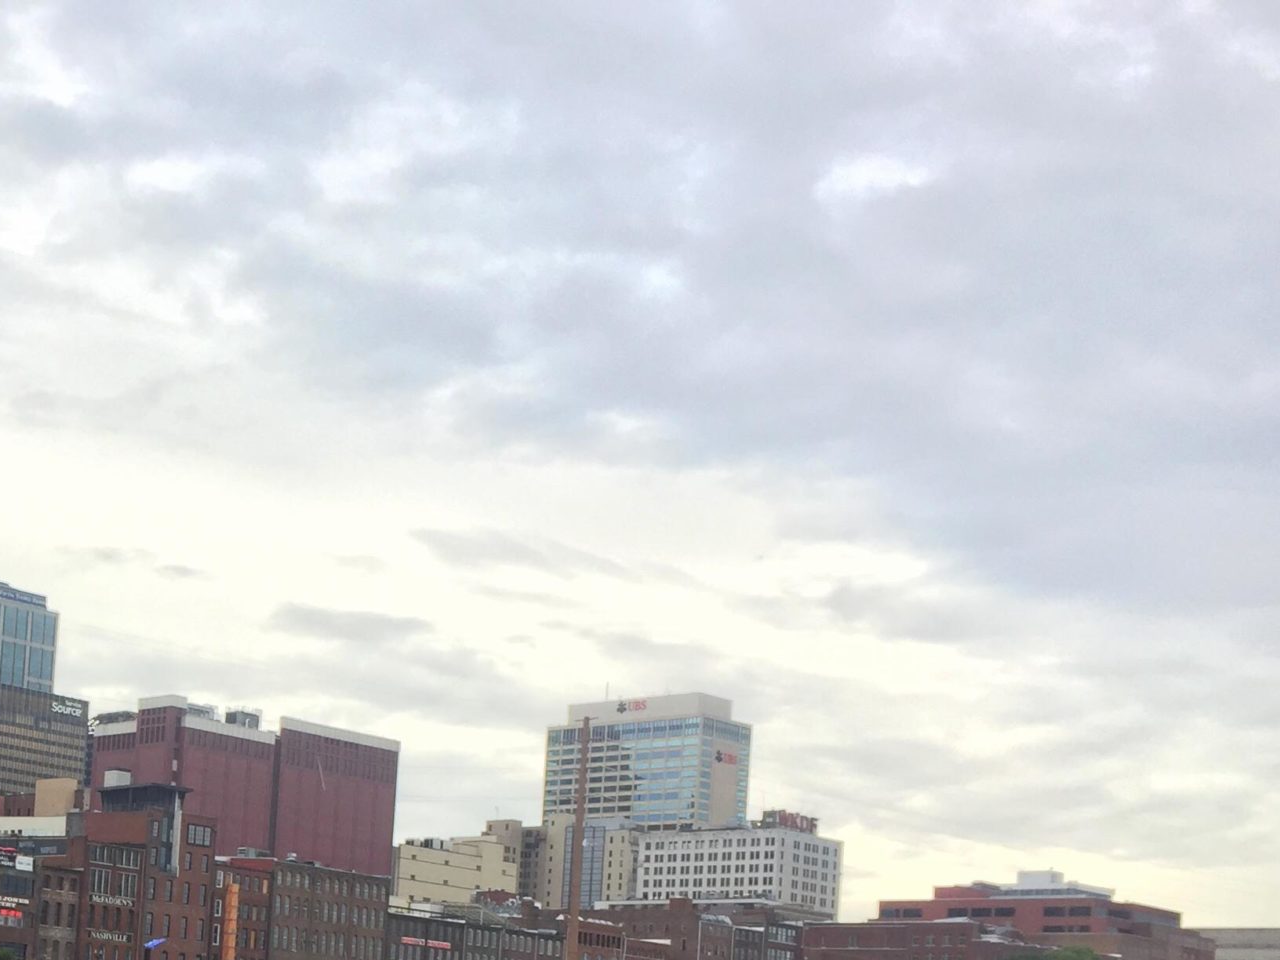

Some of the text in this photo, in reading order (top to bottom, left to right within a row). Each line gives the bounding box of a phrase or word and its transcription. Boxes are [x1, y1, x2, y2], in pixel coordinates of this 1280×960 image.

[51, 701, 82, 717] Source
[628, 700, 648, 712] UBS
[2, 895, 30, 905] JONES
[91, 931, 128, 942] NASHVILLE
